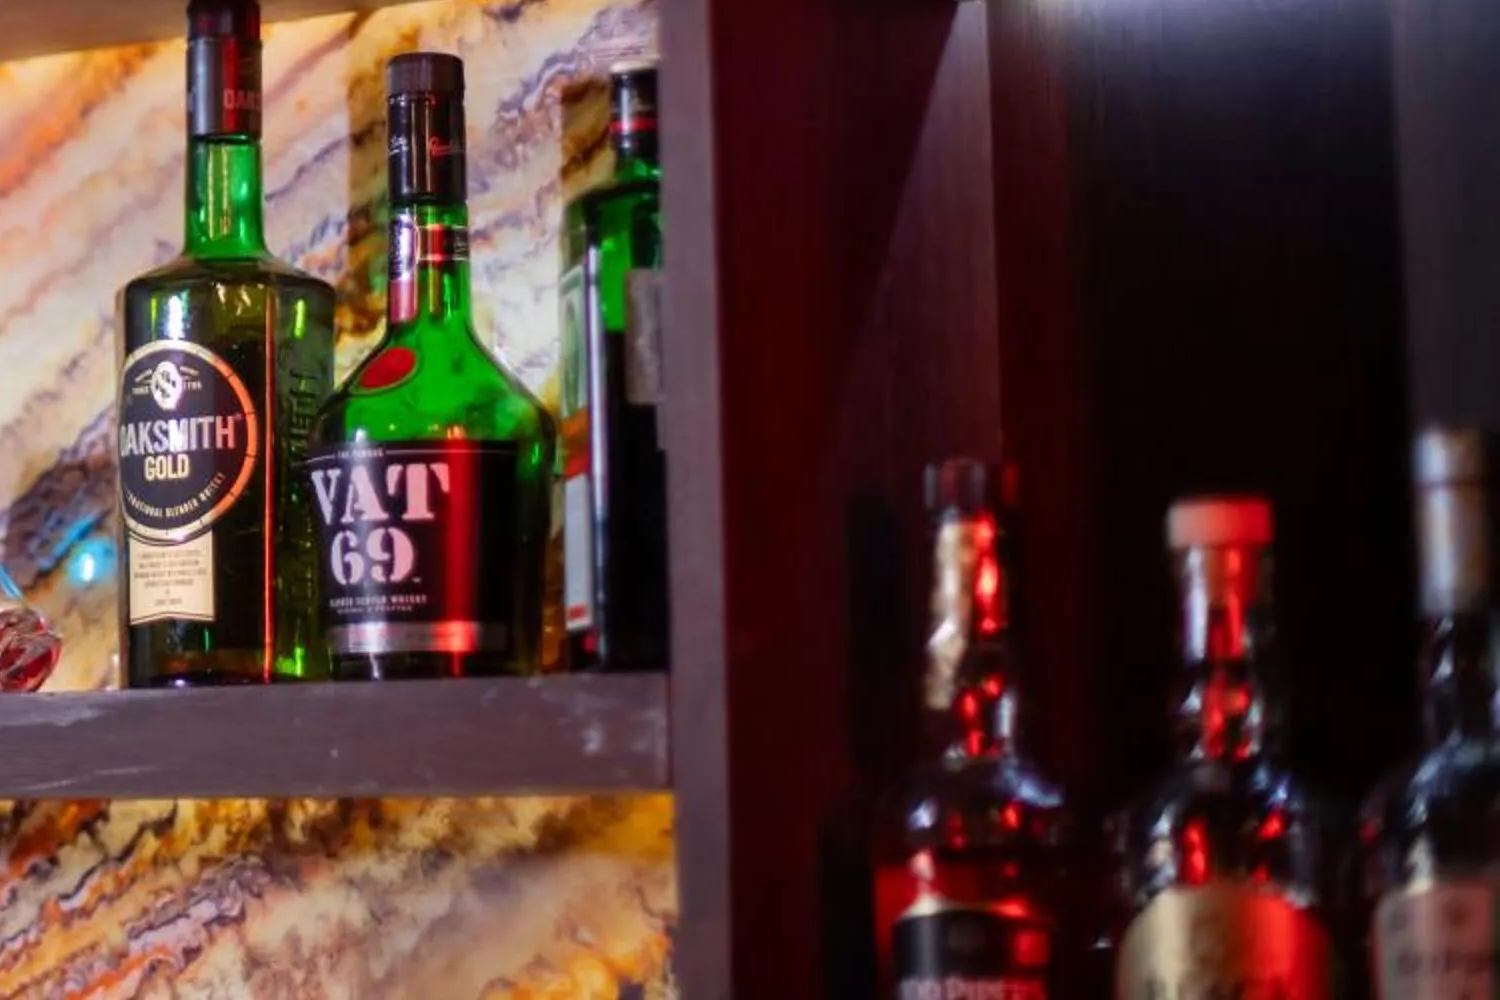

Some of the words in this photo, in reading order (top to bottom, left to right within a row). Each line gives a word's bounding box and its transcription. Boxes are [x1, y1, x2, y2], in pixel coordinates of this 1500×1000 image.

[143, 453, 190, 482] GOLD
[311, 462, 451, 526] VAT
[331, 527, 414, 586] 69
